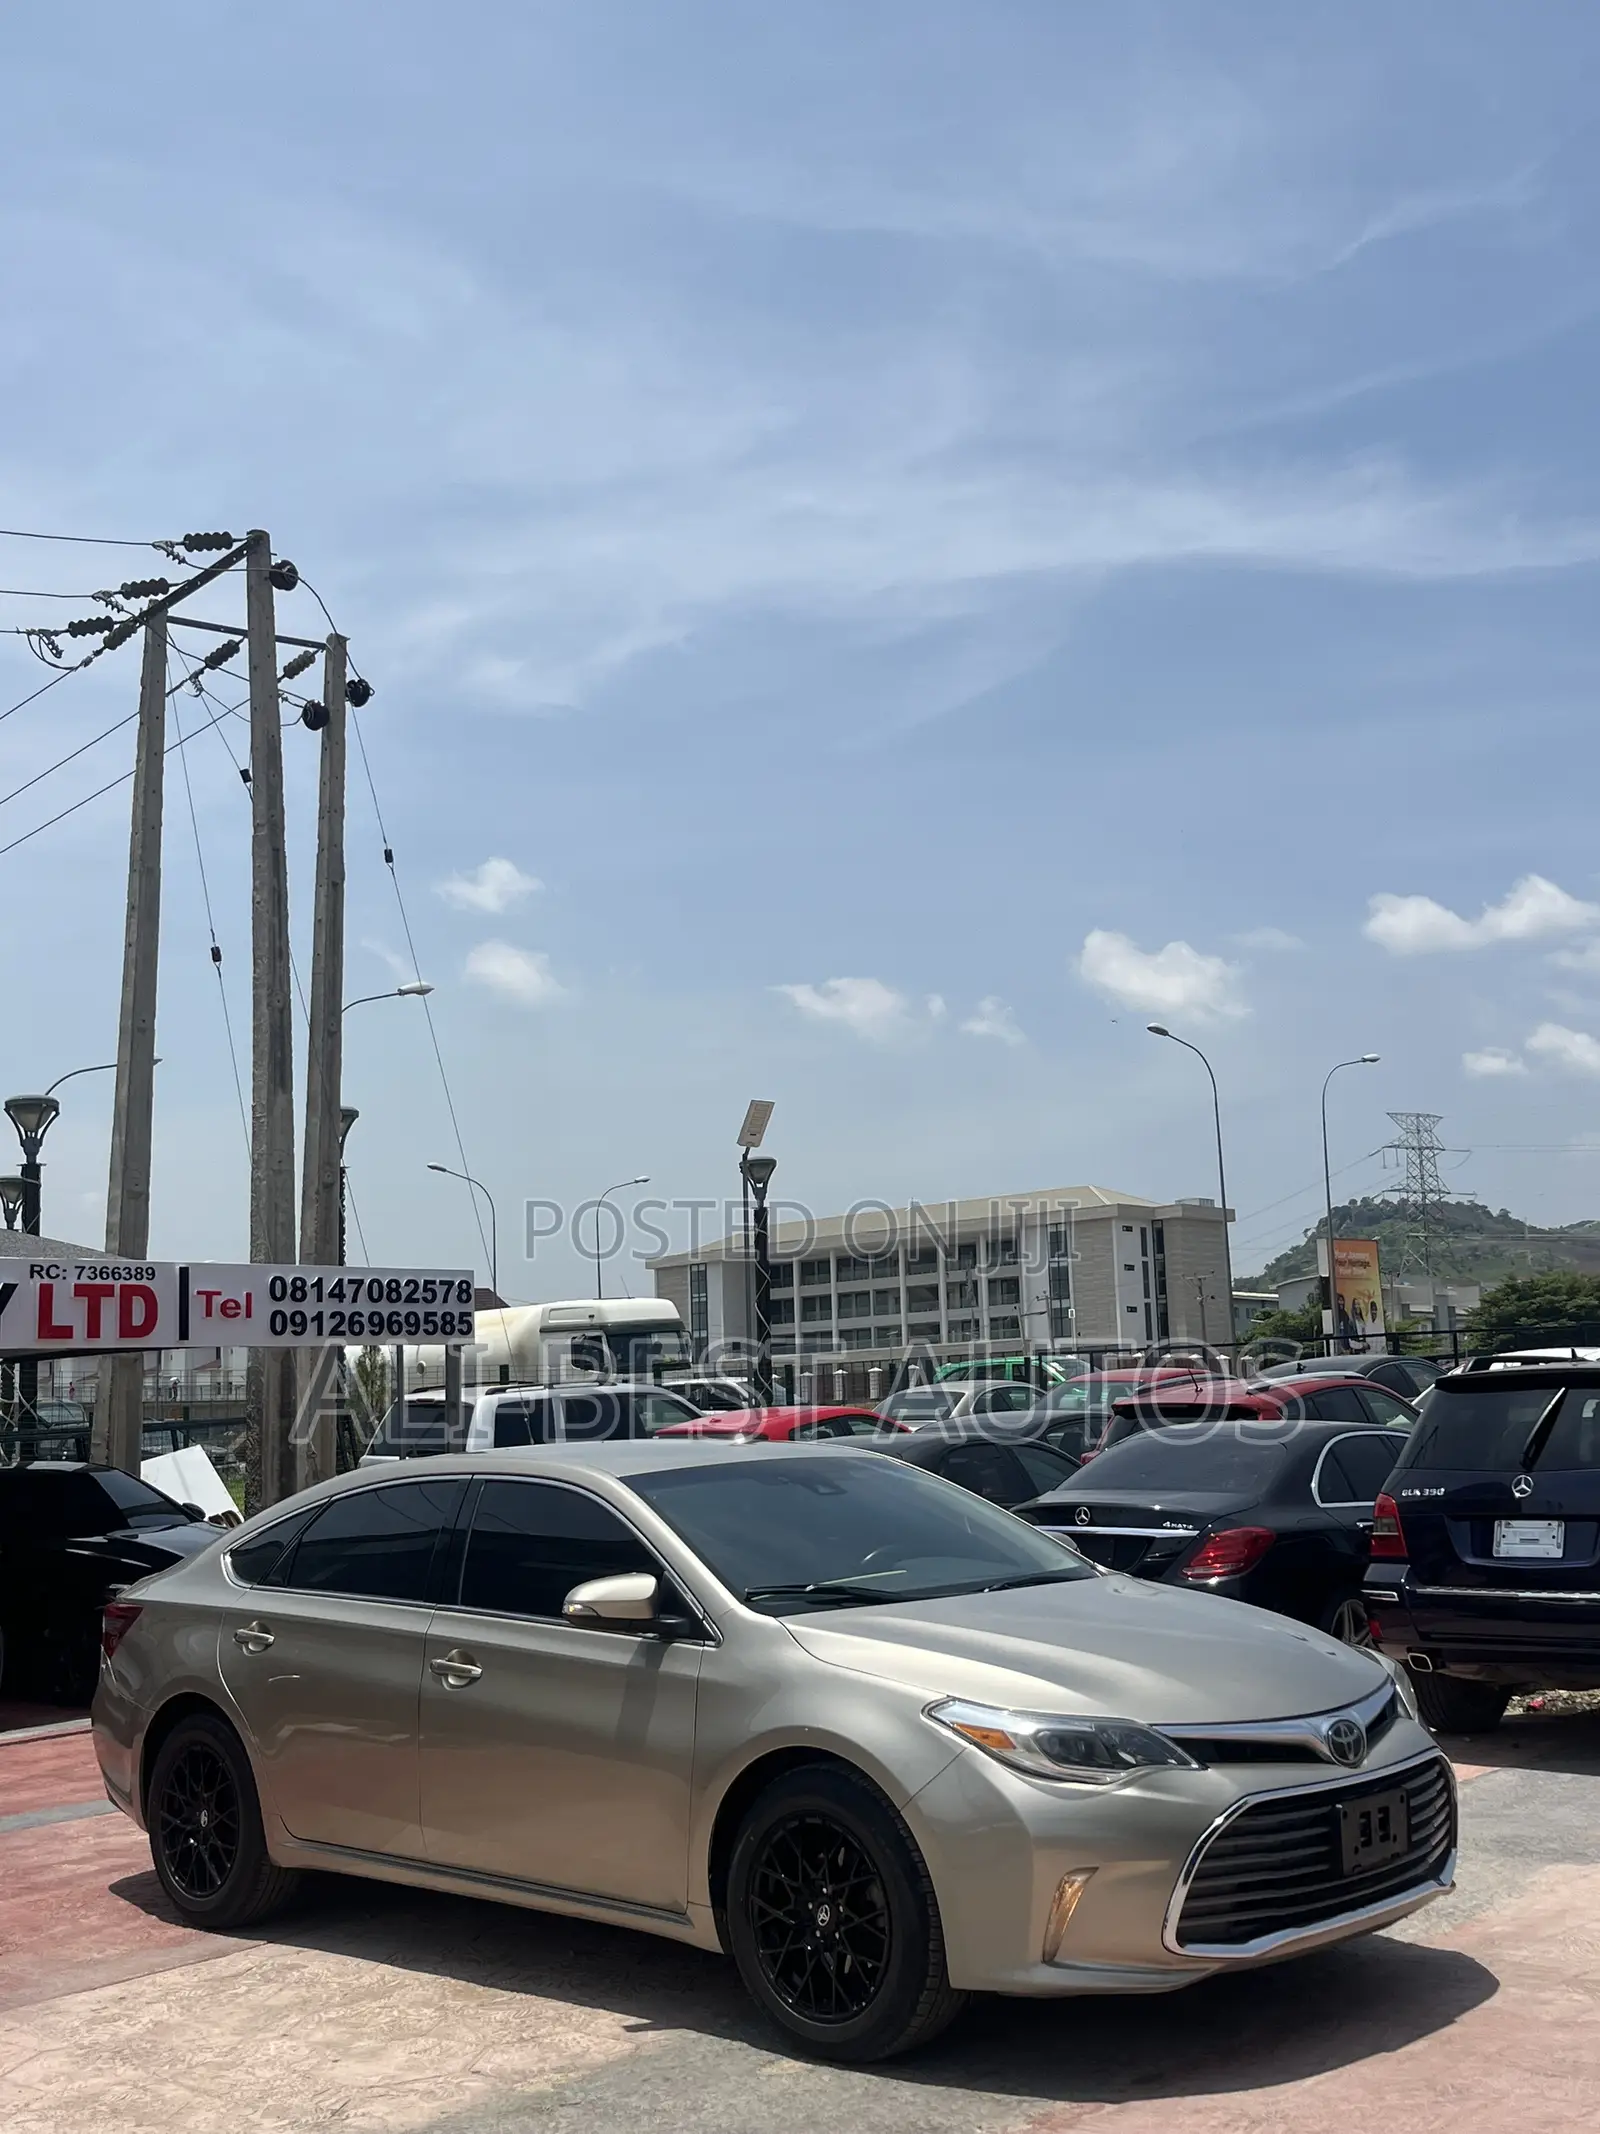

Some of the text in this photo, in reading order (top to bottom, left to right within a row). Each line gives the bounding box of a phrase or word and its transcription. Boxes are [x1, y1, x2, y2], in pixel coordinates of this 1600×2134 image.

[29, 1263, 156, 1281] RC: 7366389
[195, 1289, 252, 1319] Tel
[269, 1275, 473, 1304] 08147082578
[37, 1282, 158, 1340] LTD
[269, 1309, 473, 1337] 09126969585
